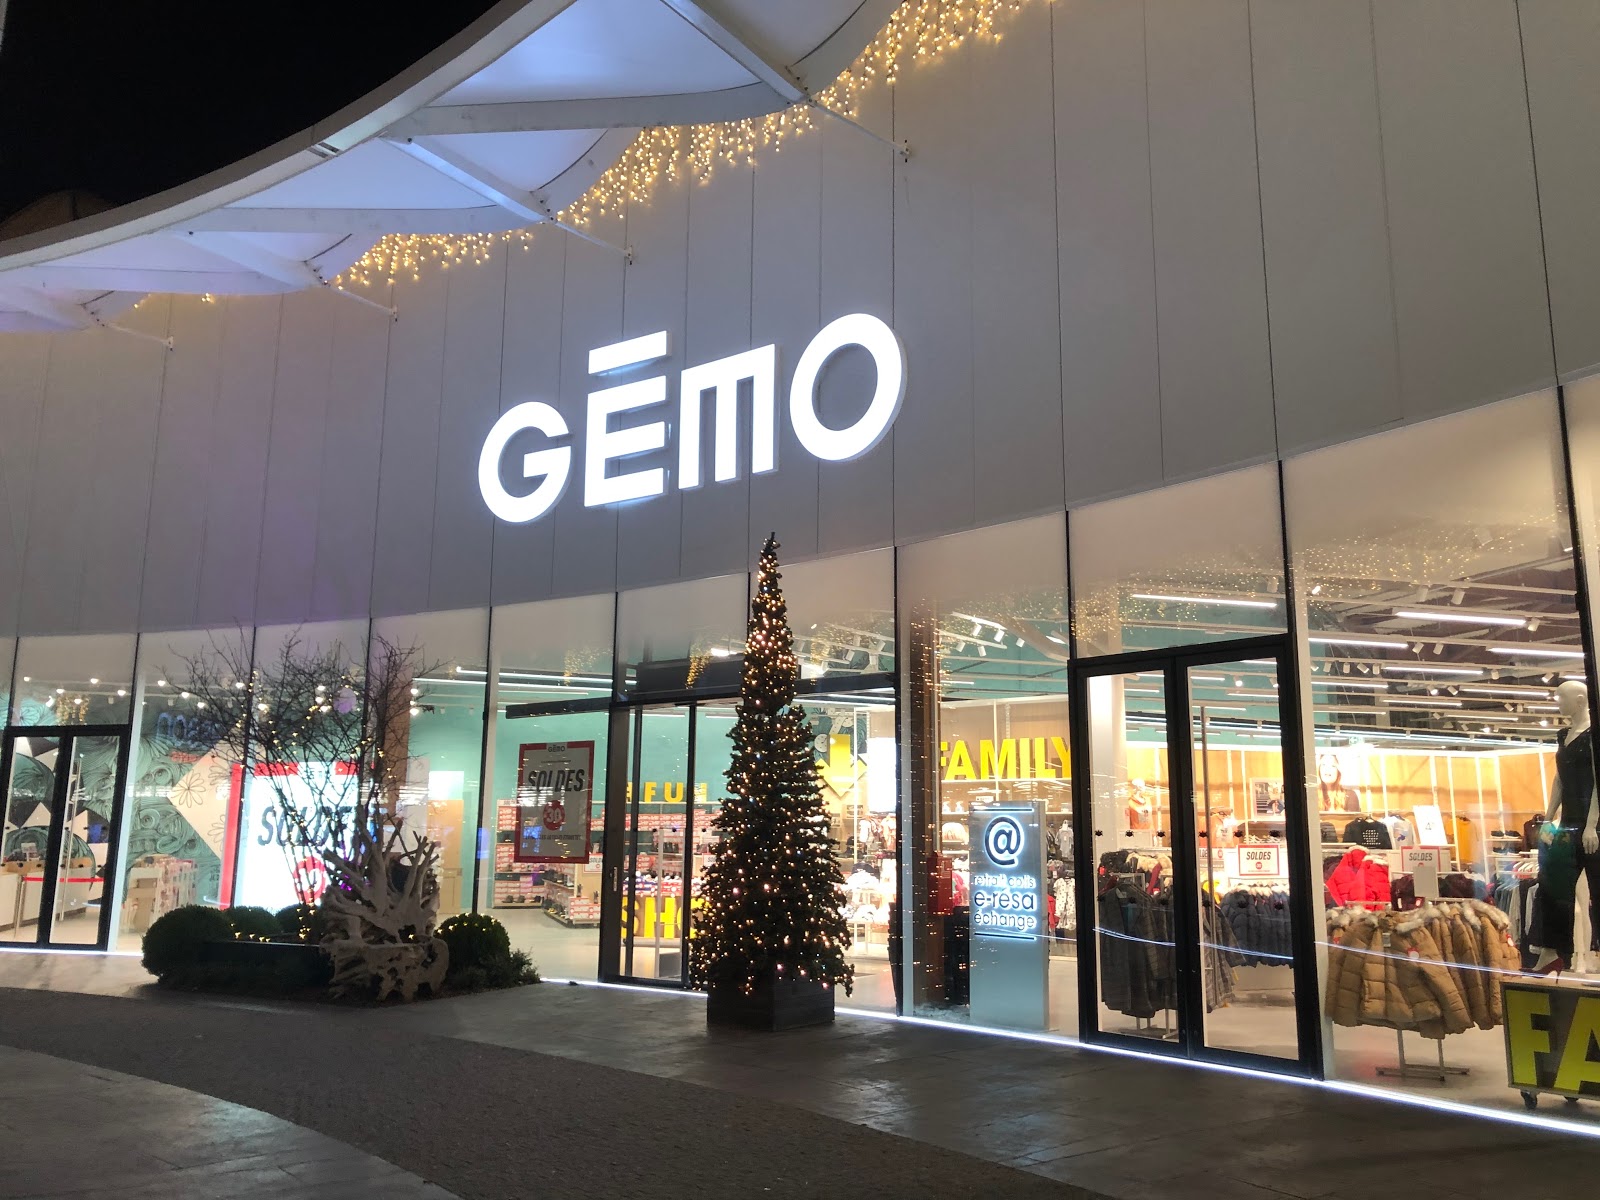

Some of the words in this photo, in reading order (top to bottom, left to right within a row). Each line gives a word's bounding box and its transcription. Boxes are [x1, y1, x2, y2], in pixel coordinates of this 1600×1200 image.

[528, 769, 585, 793] SOLDES
[257, 805, 354, 847] SOLDE
[1246, 851, 1271, 861] SOLDES
[1409, 852, 1433, 862] SOLDES
[974, 888, 1034, 910] e-résa
[974, 909, 1035, 931] échange
